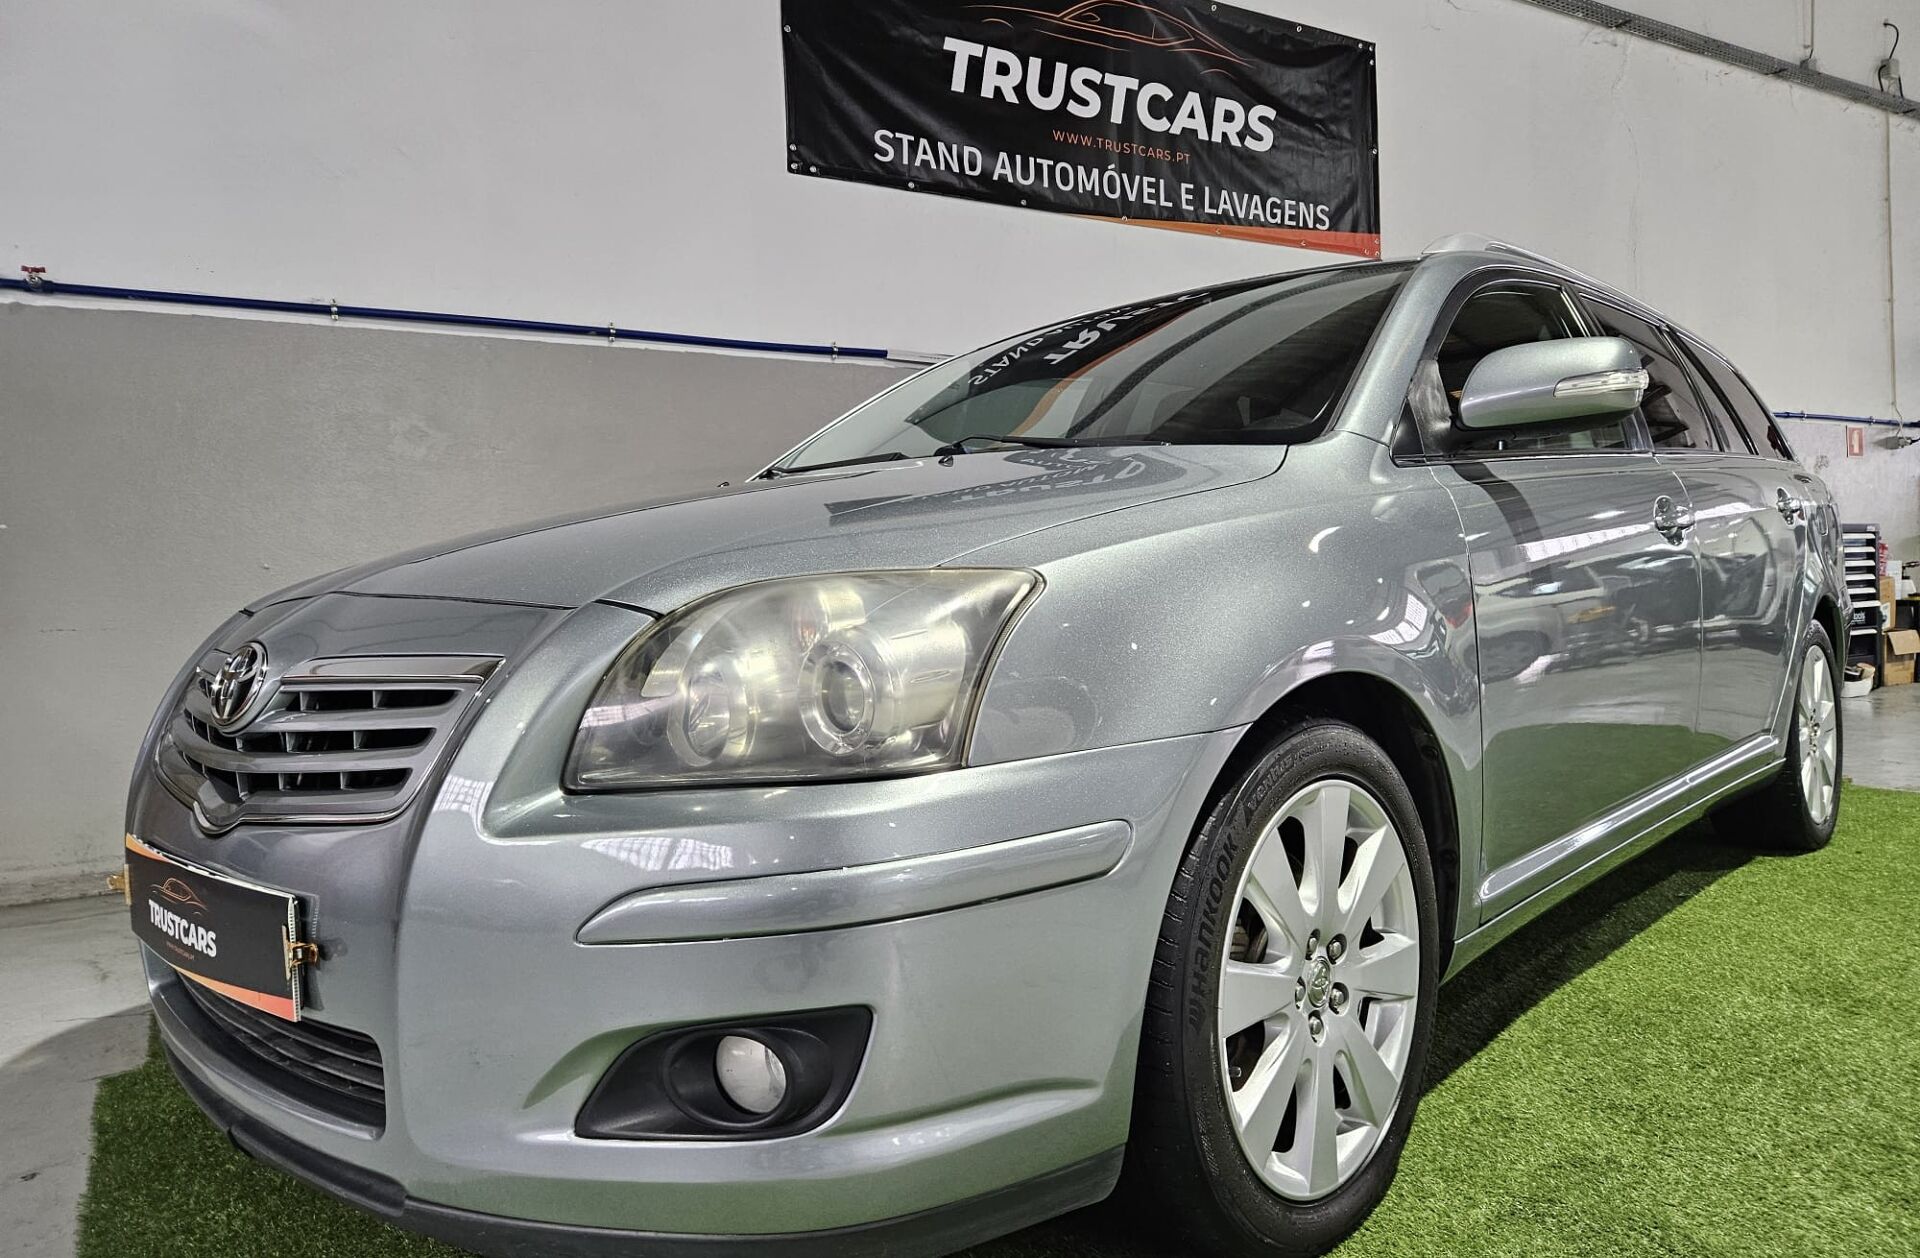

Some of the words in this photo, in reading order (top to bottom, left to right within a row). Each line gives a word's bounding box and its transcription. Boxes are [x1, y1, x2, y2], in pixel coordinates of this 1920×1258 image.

[943, 36, 1277, 152] TRUSTCARS
[874, 129, 983, 177] STAND
[992, 151, 1173, 208] AUTOMÓVEL
[1180, 182, 1195, 212] E
[1203, 185, 1331, 231] LAVAGENS
[1052, 129, 1191, 165] WWW.TRUSTCARS.PT
[148, 898, 217, 958] TRUSTCARS
